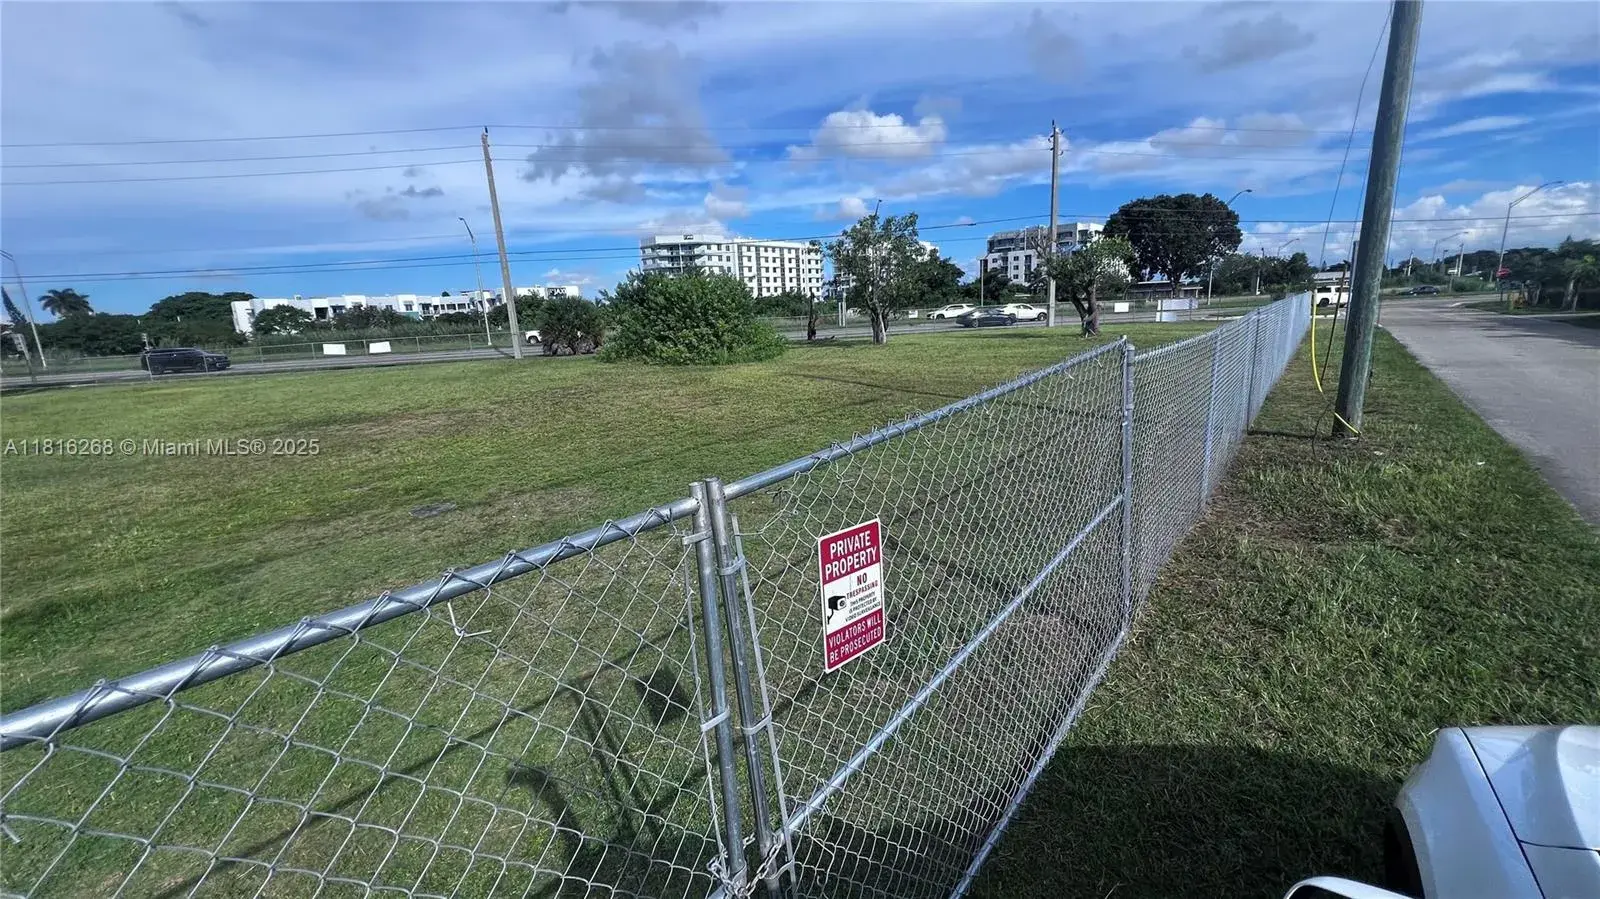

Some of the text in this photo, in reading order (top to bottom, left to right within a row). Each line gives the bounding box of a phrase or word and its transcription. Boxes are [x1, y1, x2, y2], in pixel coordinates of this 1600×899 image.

[830, 530, 871, 560] PRIVATE
[825, 545, 877, 580] PROPERTY
[846, 580, 878, 599] TRESPASSING
[857, 573, 867, 586] NO
[829, 613, 881, 648] VIOLATORS WILL
[830, 626, 882, 663] BE PROSECUTED
